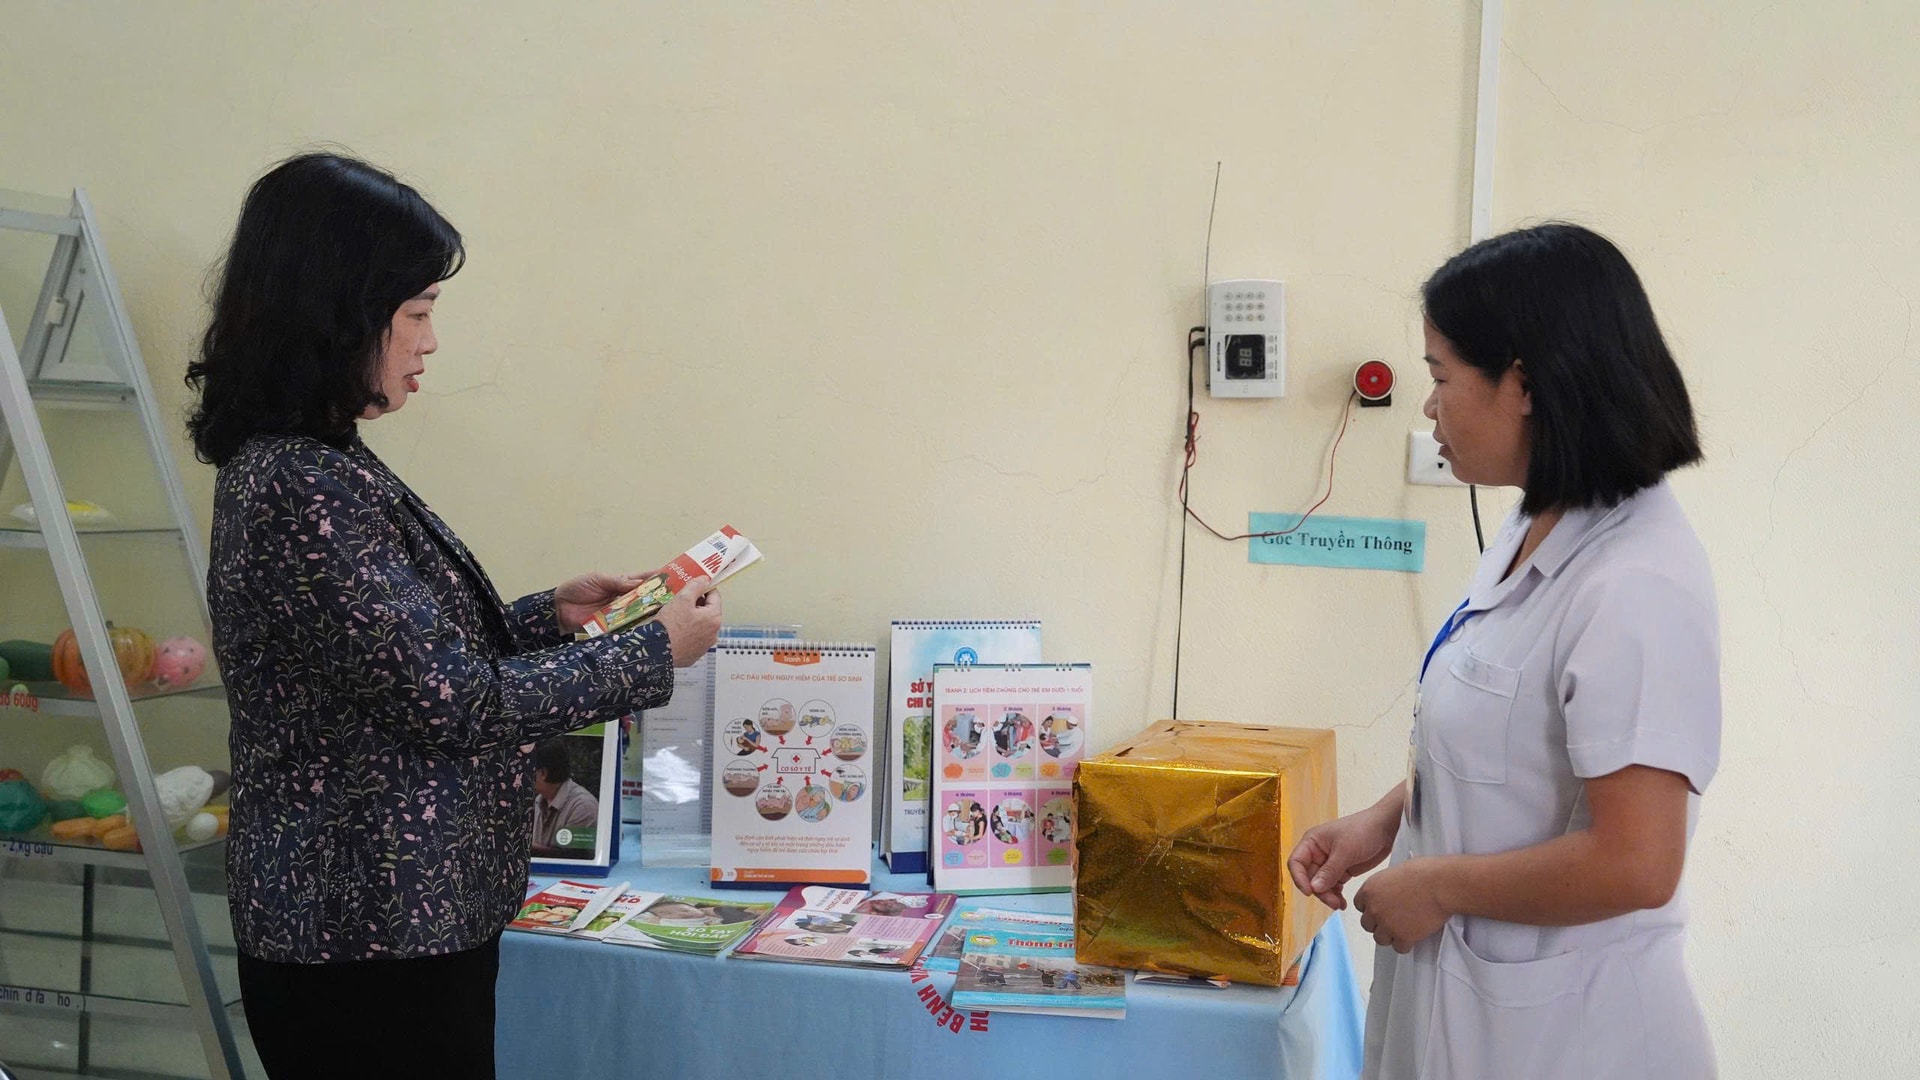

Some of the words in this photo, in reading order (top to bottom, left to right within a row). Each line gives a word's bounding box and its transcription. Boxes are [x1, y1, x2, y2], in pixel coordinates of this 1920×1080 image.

[1298, 530, 1356, 551] Truyền
[1360, 535, 1413, 554] Thông
[783, 655, 801, 663] Tranh
[13, 691, 39, 713] 600g
